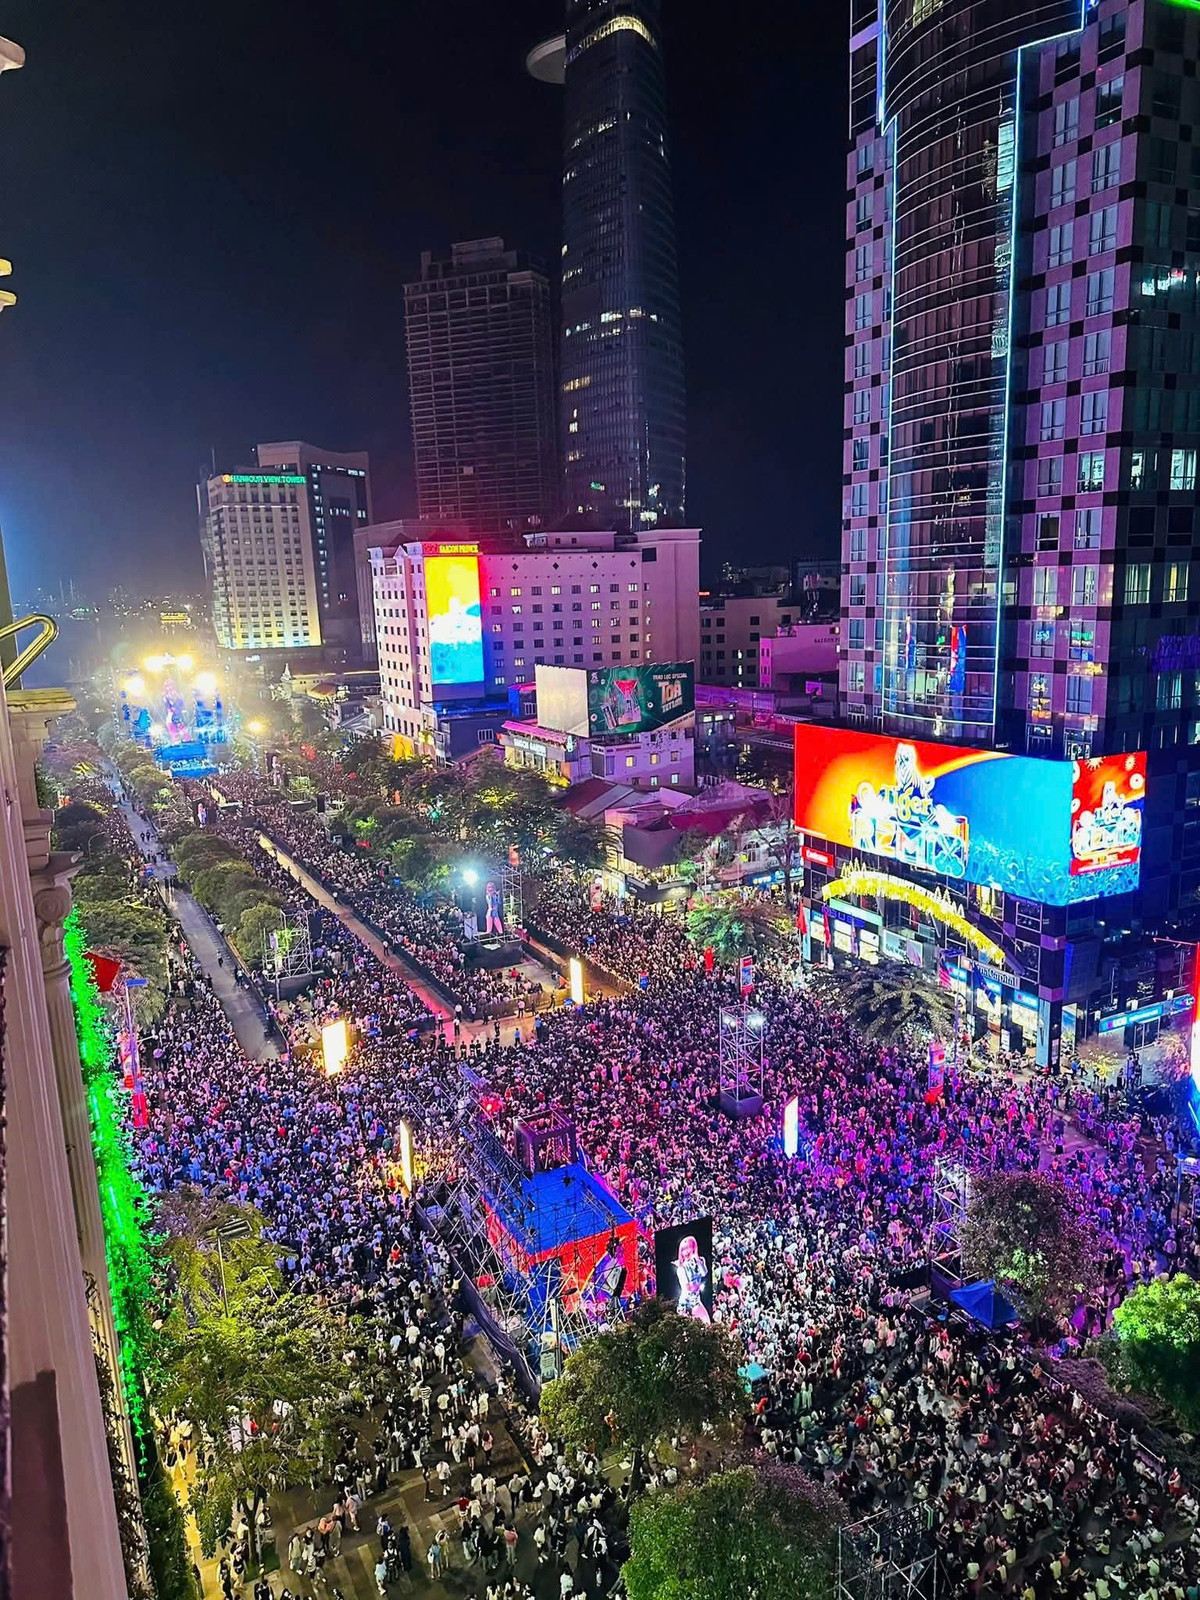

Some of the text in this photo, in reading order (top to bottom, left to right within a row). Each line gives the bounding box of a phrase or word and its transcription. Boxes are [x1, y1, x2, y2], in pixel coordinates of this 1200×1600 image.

[263, 475, 281, 483] VIEW
[282, 475, 306, 484] TOWER
[878, 784, 932, 822] Tiger
[853, 814, 964, 878] REMIX
